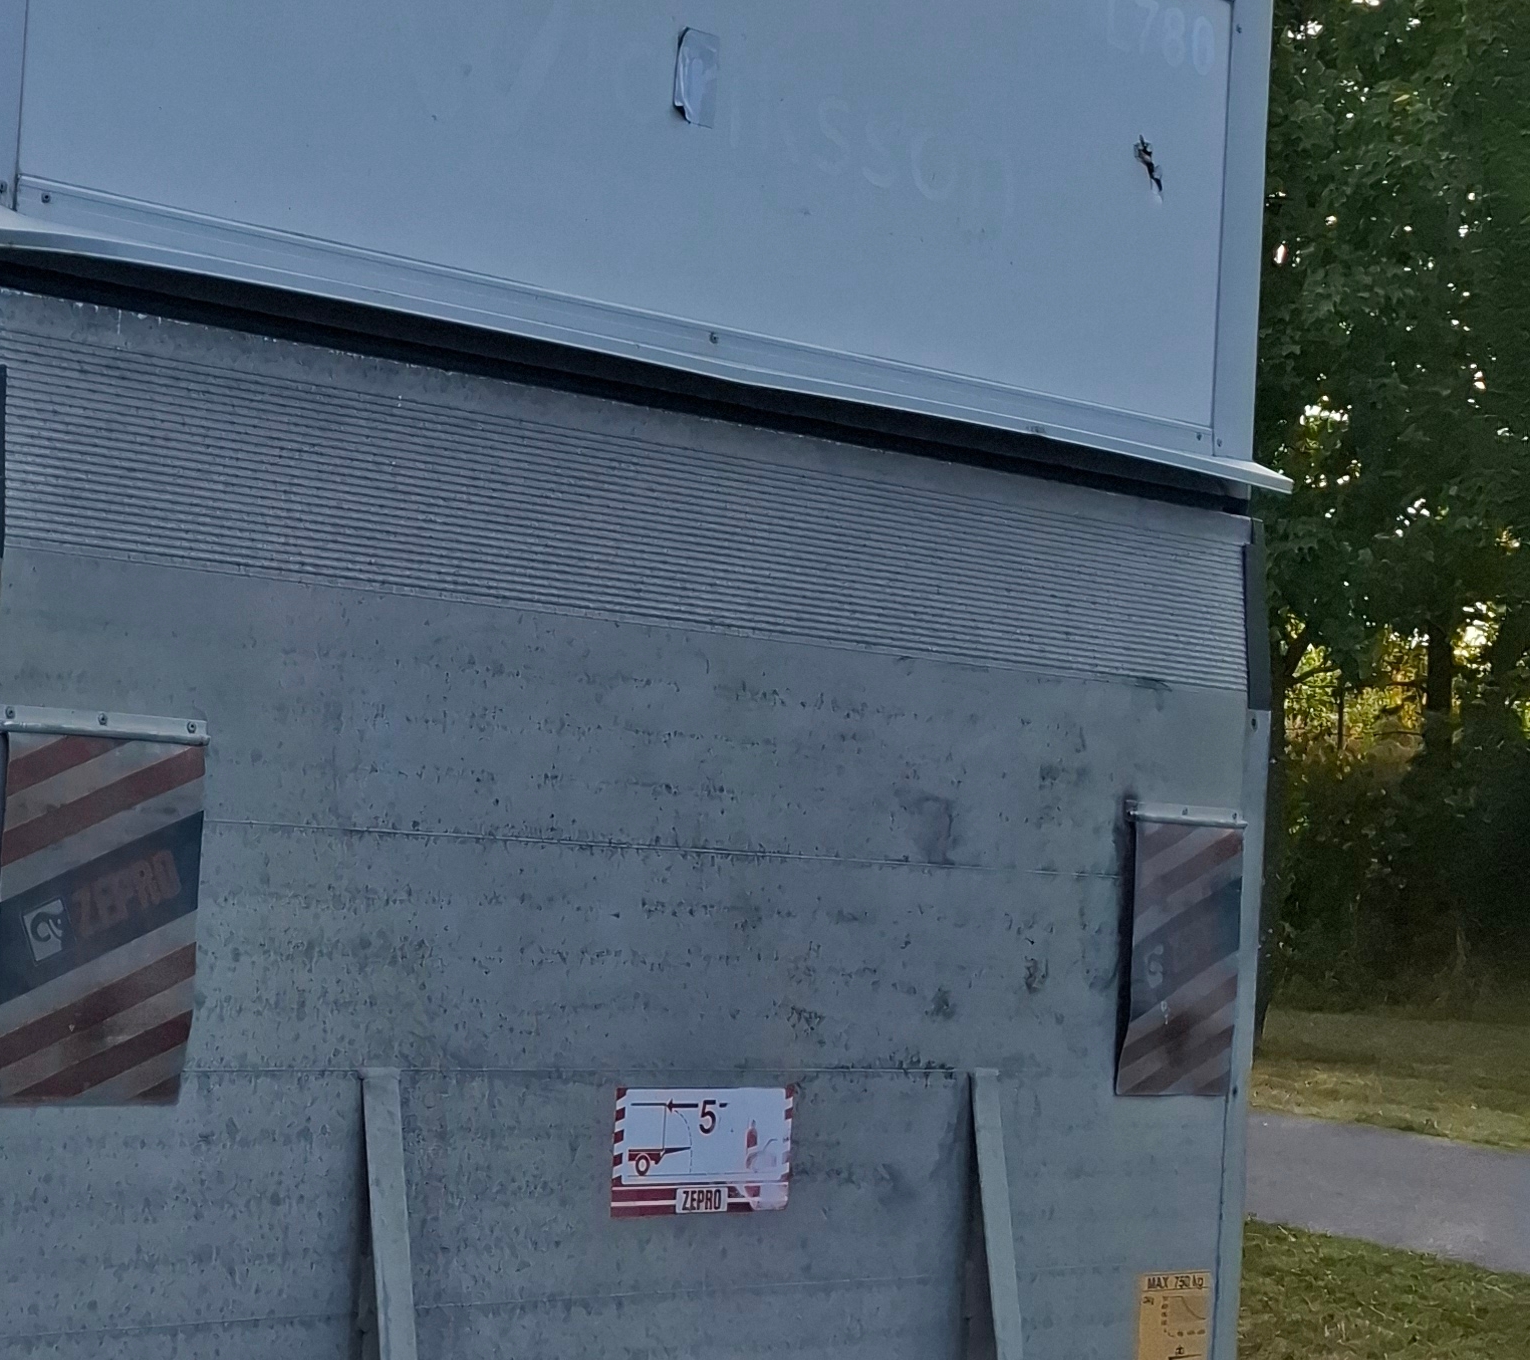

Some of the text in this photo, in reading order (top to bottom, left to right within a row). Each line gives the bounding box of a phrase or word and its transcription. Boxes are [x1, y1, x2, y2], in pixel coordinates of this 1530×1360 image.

[72, 849, 181, 938] ZEPRO
[699, 1099, 717, 1135] 5
[681, 1188, 722, 1211] ZEPRO
[1147, 1276, 1169, 1289] MAX
